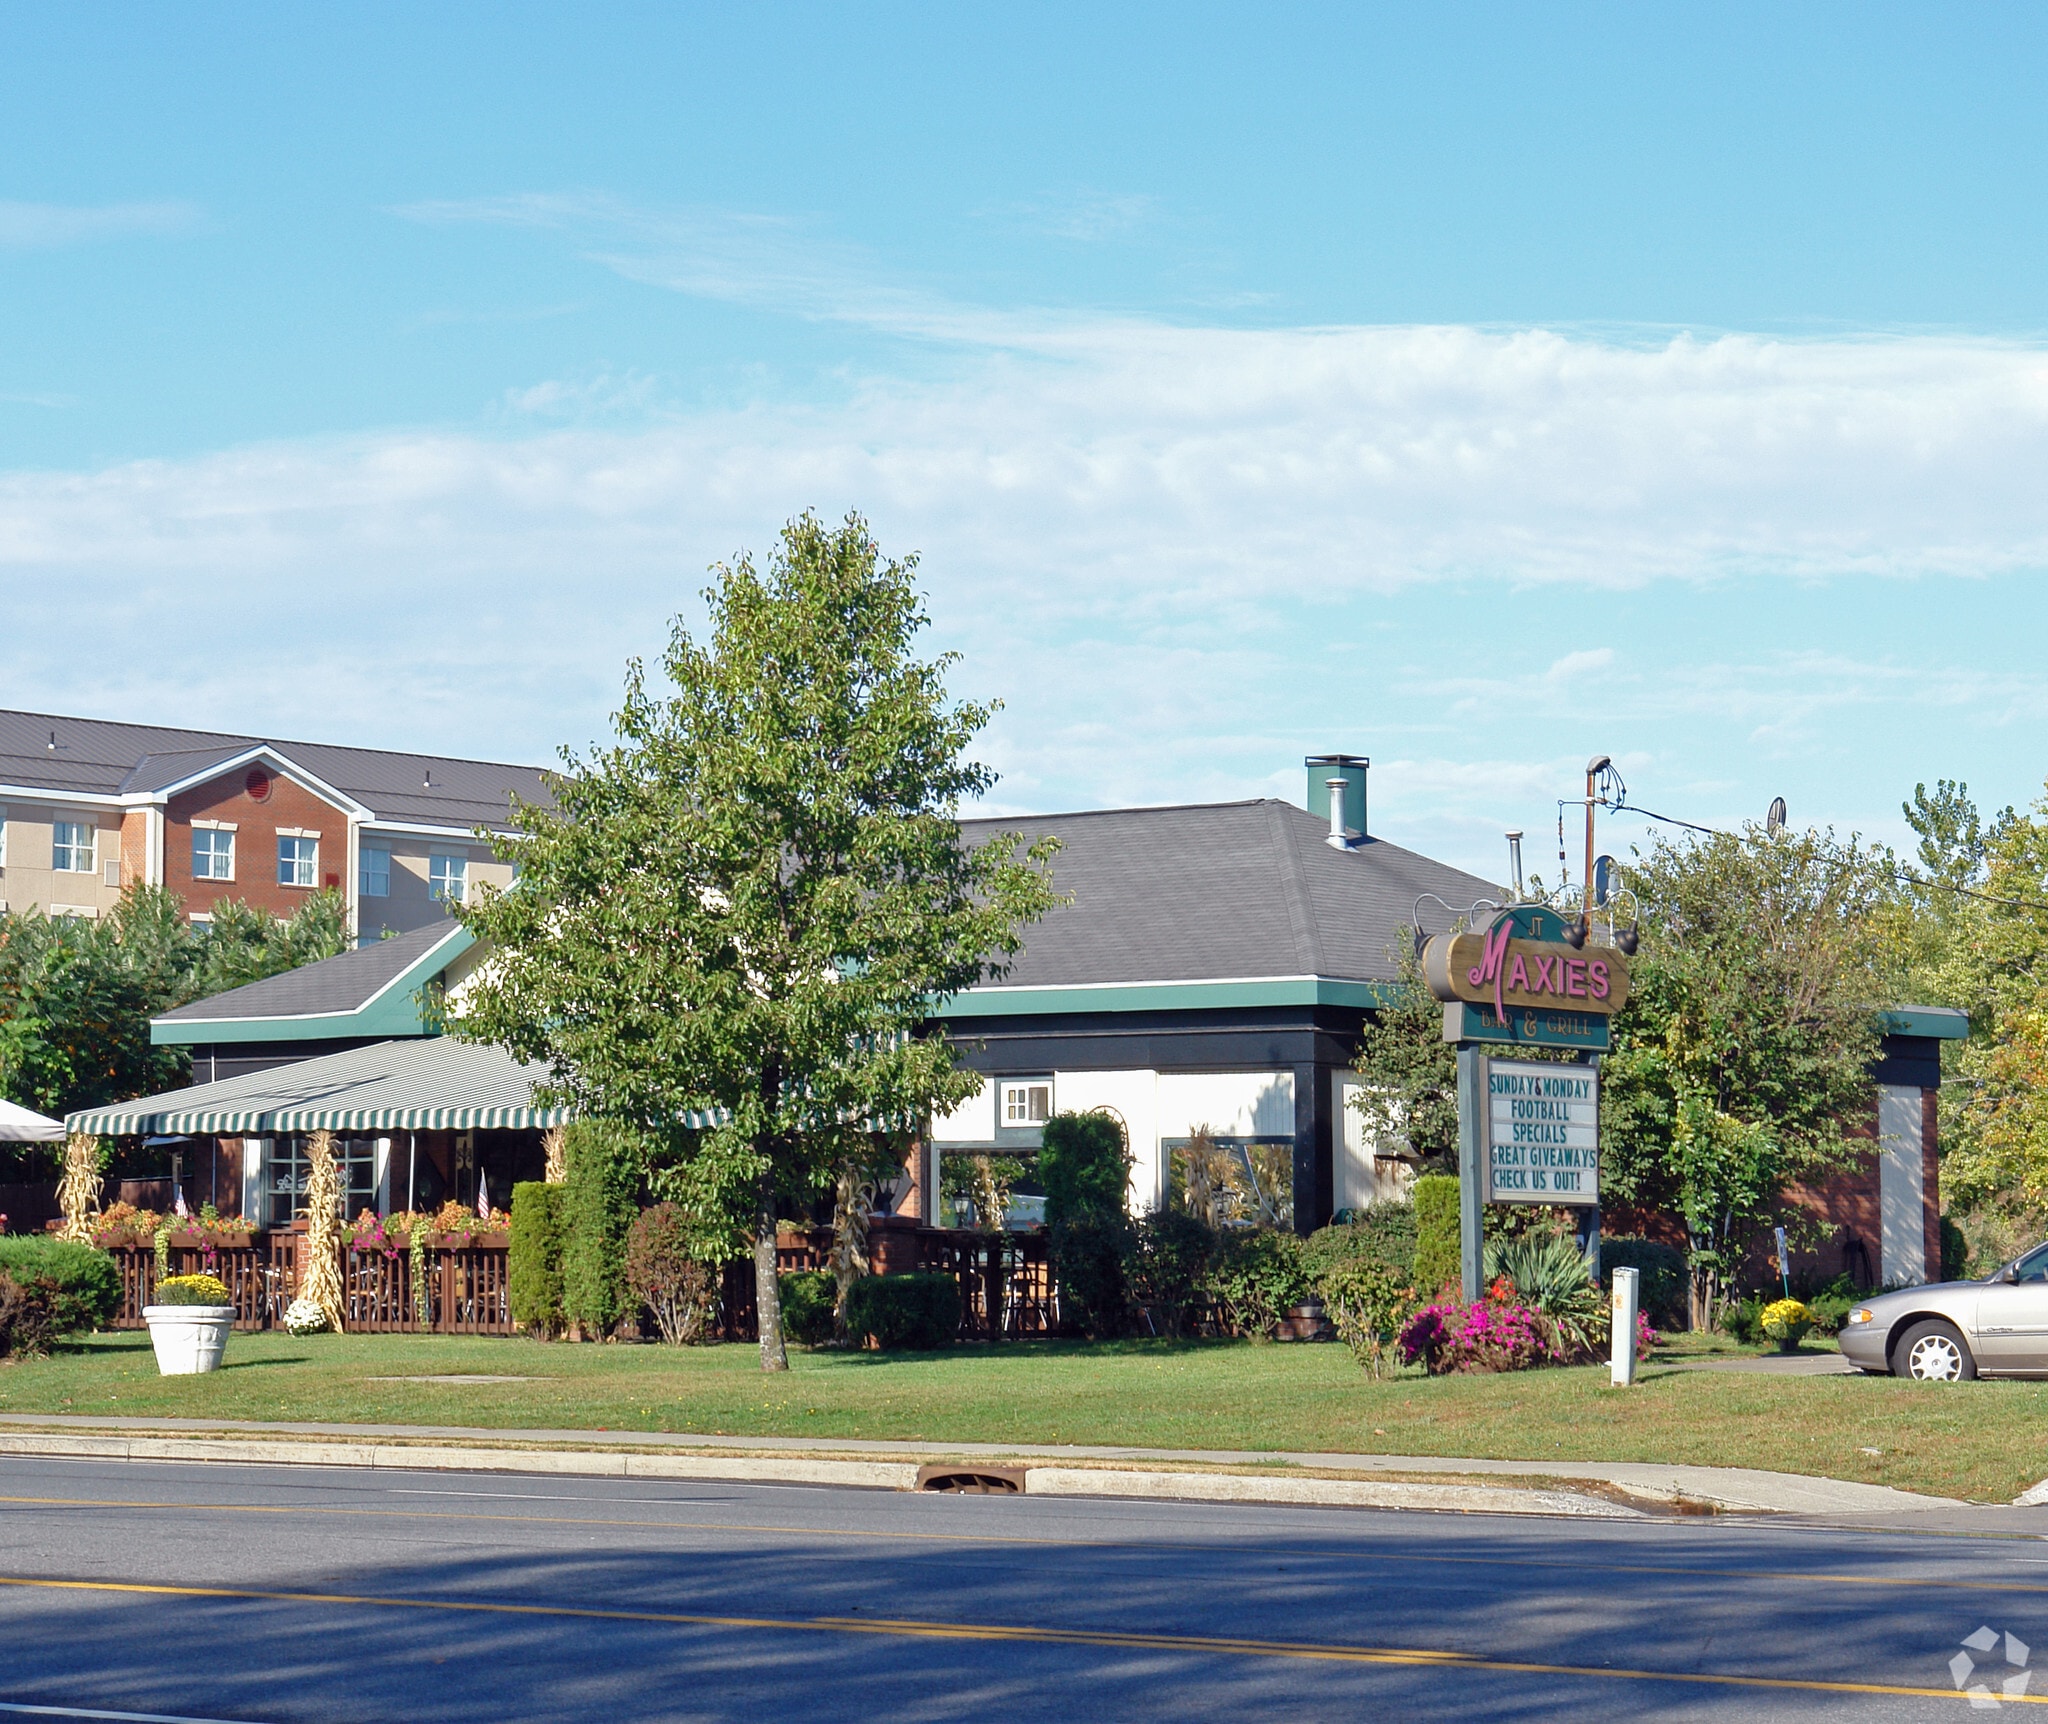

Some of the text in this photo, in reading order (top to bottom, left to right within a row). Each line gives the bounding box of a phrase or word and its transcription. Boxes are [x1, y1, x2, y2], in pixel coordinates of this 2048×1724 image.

[1528, 917, 1544, 937] JT
[1468, 918, 1610, 1024] MAXIES
[1481, 1010, 1592, 1038] BAR & GRILL
[1489, 1074, 1534, 1095] SUNDAY
[1543, 1078, 1590, 1099] MONDAY
[1511, 1099, 1570, 1121] FOOTBALL
[1513, 1123, 1567, 1144] SPECIALS
[1491, 1146, 1596, 1168] GREAT GIVEAWAYS
[1492, 1169, 1581, 1191] CHECK US OUT!
